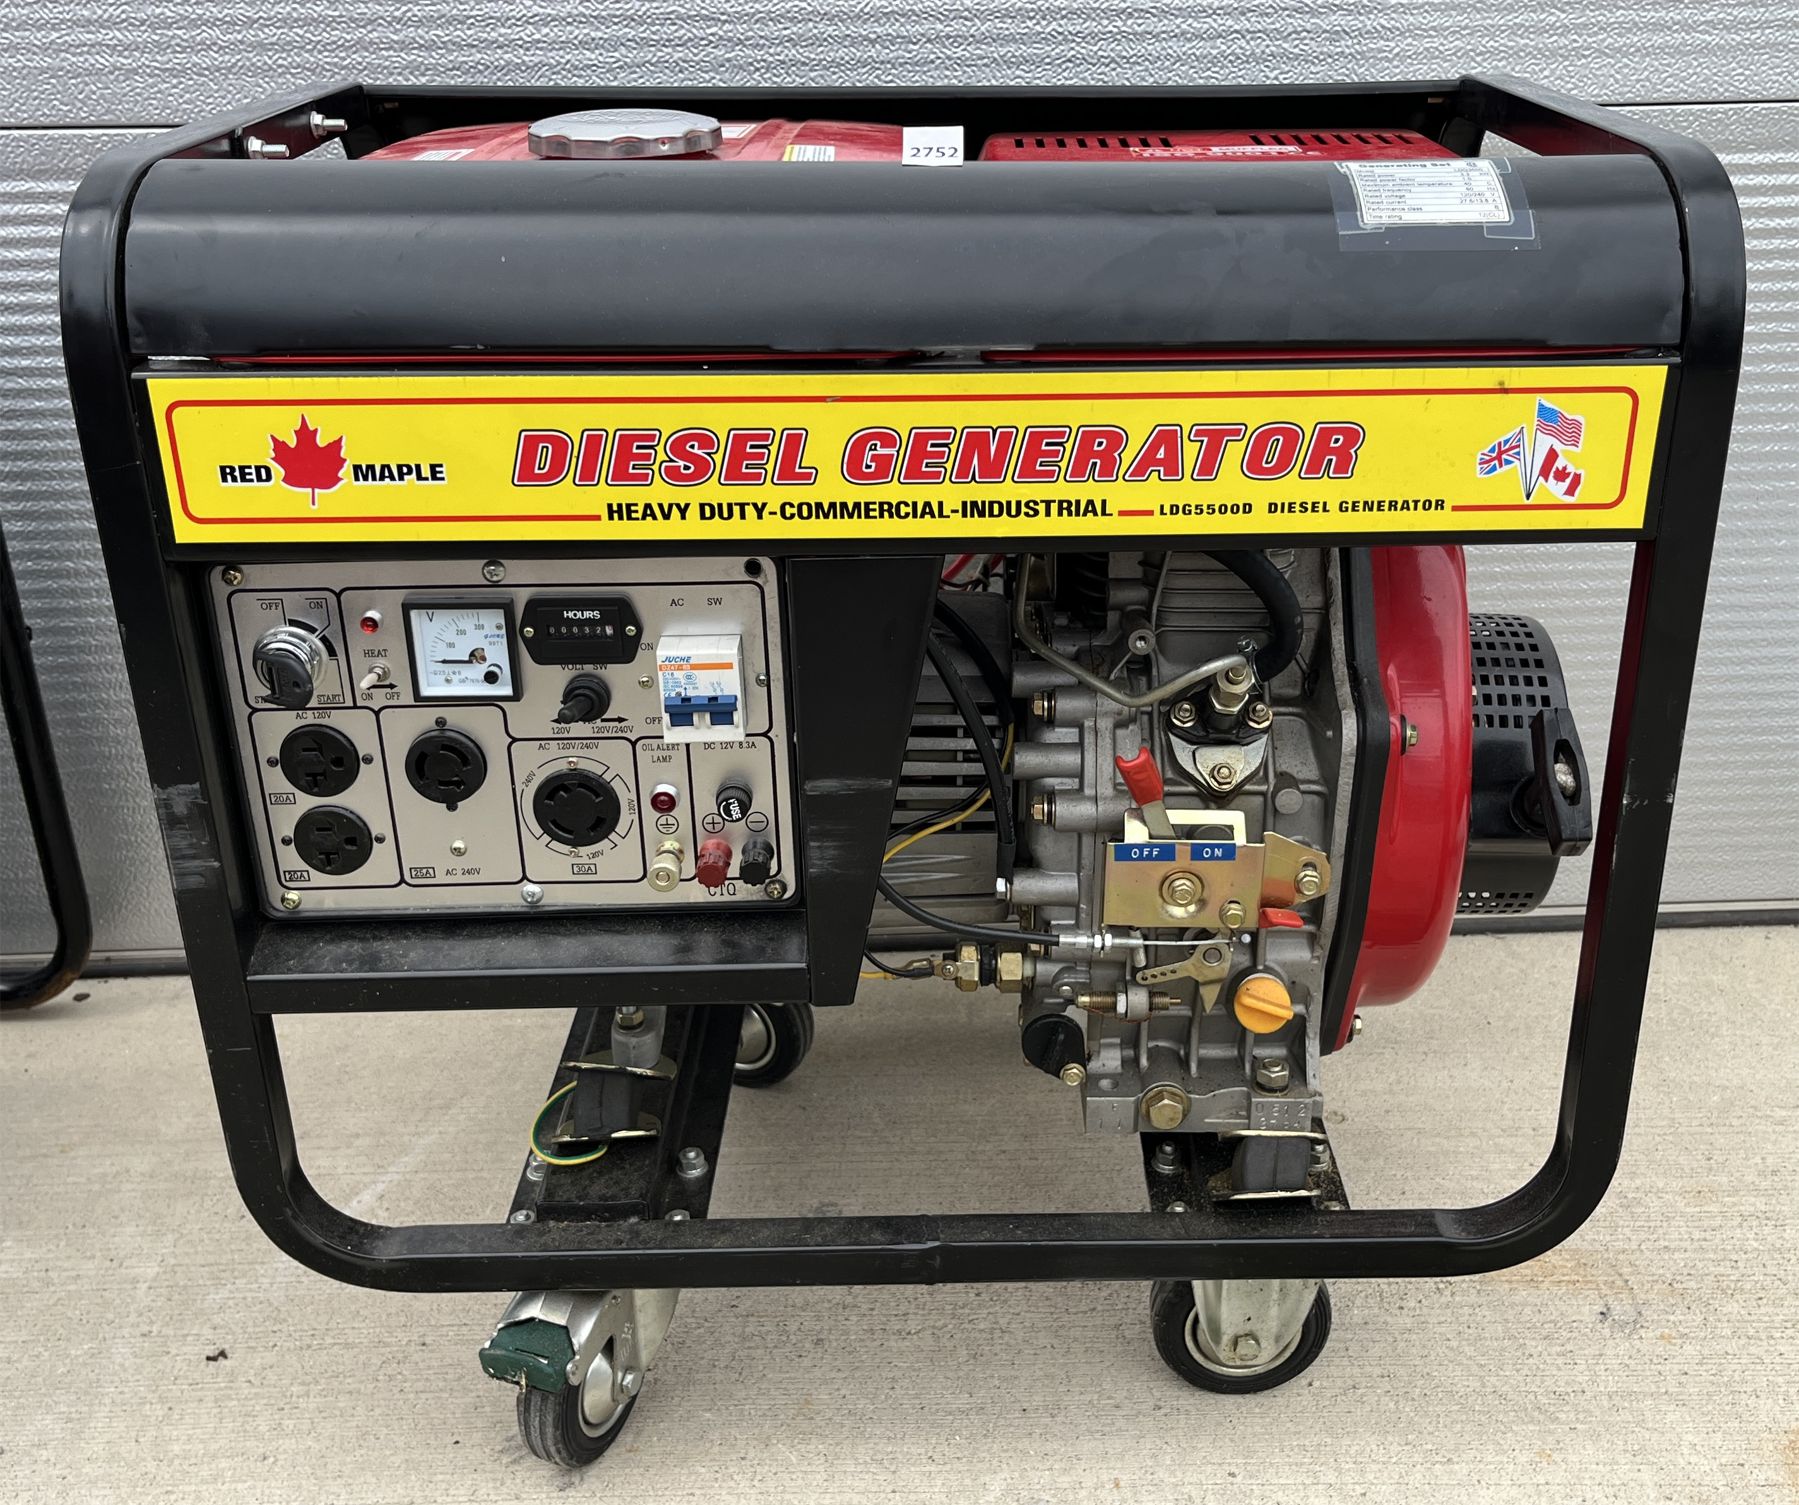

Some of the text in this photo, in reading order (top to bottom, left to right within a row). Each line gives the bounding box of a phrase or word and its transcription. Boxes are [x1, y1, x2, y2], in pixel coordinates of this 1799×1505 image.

[910, 146, 959, 158] 2752
[512, 421, 1366, 487] DIESEL GENERATOR
[219, 463, 445, 483] RED MAPLE
[606, 499, 1113, 521] HEAVY DUTY-COMMERCIAL-INDUSTRIAL
[1159, 498, 1445, 516] LDG5500D DIESEL GENERATOR
[260, 602, 280, 611] OFF
[309, 601, 323, 610] ON
[670, 598, 722, 607] AC SW
[426, 611, 434, 622] V
[563, 610, 601, 620] HOURS
[364, 650, 388, 658] HEAT
[317, 694, 342, 703] START
[361, 692, 373, 701] ON
[385, 692, 401, 701] OFF
[311, 711, 332, 719] 120V
[645, 716, 663, 725] OFF
[551, 726, 571, 735] 120V
[591, 725, 634, 735] 120V/240V
[557, 741, 599, 750] 120V/240V
[642, 744, 680, 752] OIL ALERT
[703, 742, 716, 750] DC
[739, 741, 757, 749] 8.3A
[651, 755, 673, 763] LAMP
[522, 770, 536, 788] 240V
[273, 794, 293, 803] 20A
[728, 799, 742, 820] FUSE
[586, 850, 604, 860] 120V
[1131, 848, 1160, 858] OFF
[1203, 847, 1223, 858] ON
[413, 868, 481, 877] 25A AC 240V
[575, 864, 593, 873] 30A
[287, 871, 307, 880] 20A
[707, 883, 737, 896] CTQ
